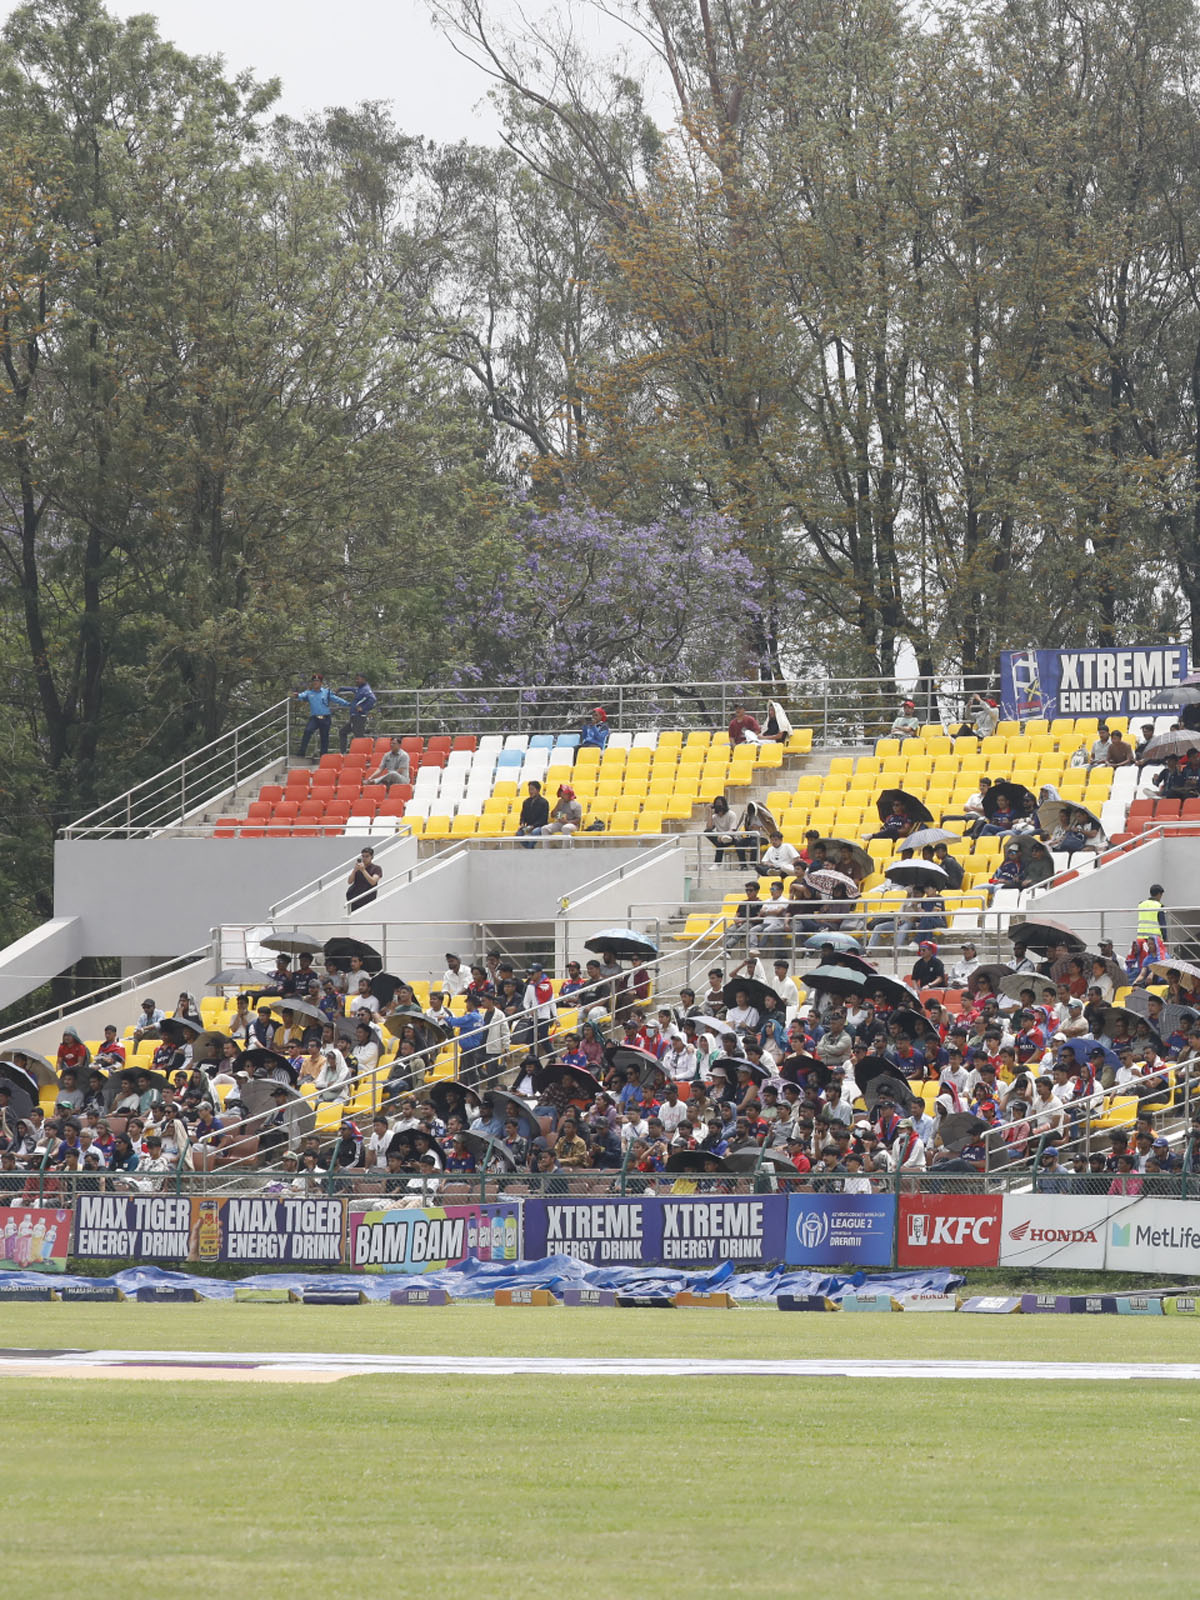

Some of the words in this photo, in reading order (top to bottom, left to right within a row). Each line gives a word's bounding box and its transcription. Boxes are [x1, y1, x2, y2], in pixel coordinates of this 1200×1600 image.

[1060, 651, 1181, 689] XTREME
[1060, 691, 1123, 713] ENERGY
[80, 1196, 129, 1230] MAX
[134, 1198, 191, 1231] TIGER
[228, 1199, 279, 1233] MAX
[283, 1200, 342, 1234] TIGER
[546, 1204, 643, 1239] XTREME
[663, 1202, 764, 1238] XTREME
[831, 1219, 866, 1228] LEAGUE
[867, 1219, 873, 1229] 2
[78, 1230, 138, 1256] ENERGY
[141, 1232, 191, 1257] DRINK
[354, 1222, 408, 1265] BAM
[410, 1219, 465, 1262] BAM
[930, 1217, 993, 1244] KFC
[1030, 1228, 1098, 1243] HONDA
[1135, 1225, 1200, 1249] MetLife
[227, 1233, 289, 1259] ENERGY
[291, 1234, 341, 1260] DRINK
[547, 1241, 597, 1260] ENERGY
[601, 1240, 643, 1260] DRINK
[663, 1239, 716, 1260] ENERGY
[719, 1238, 763, 1260] DRINK
